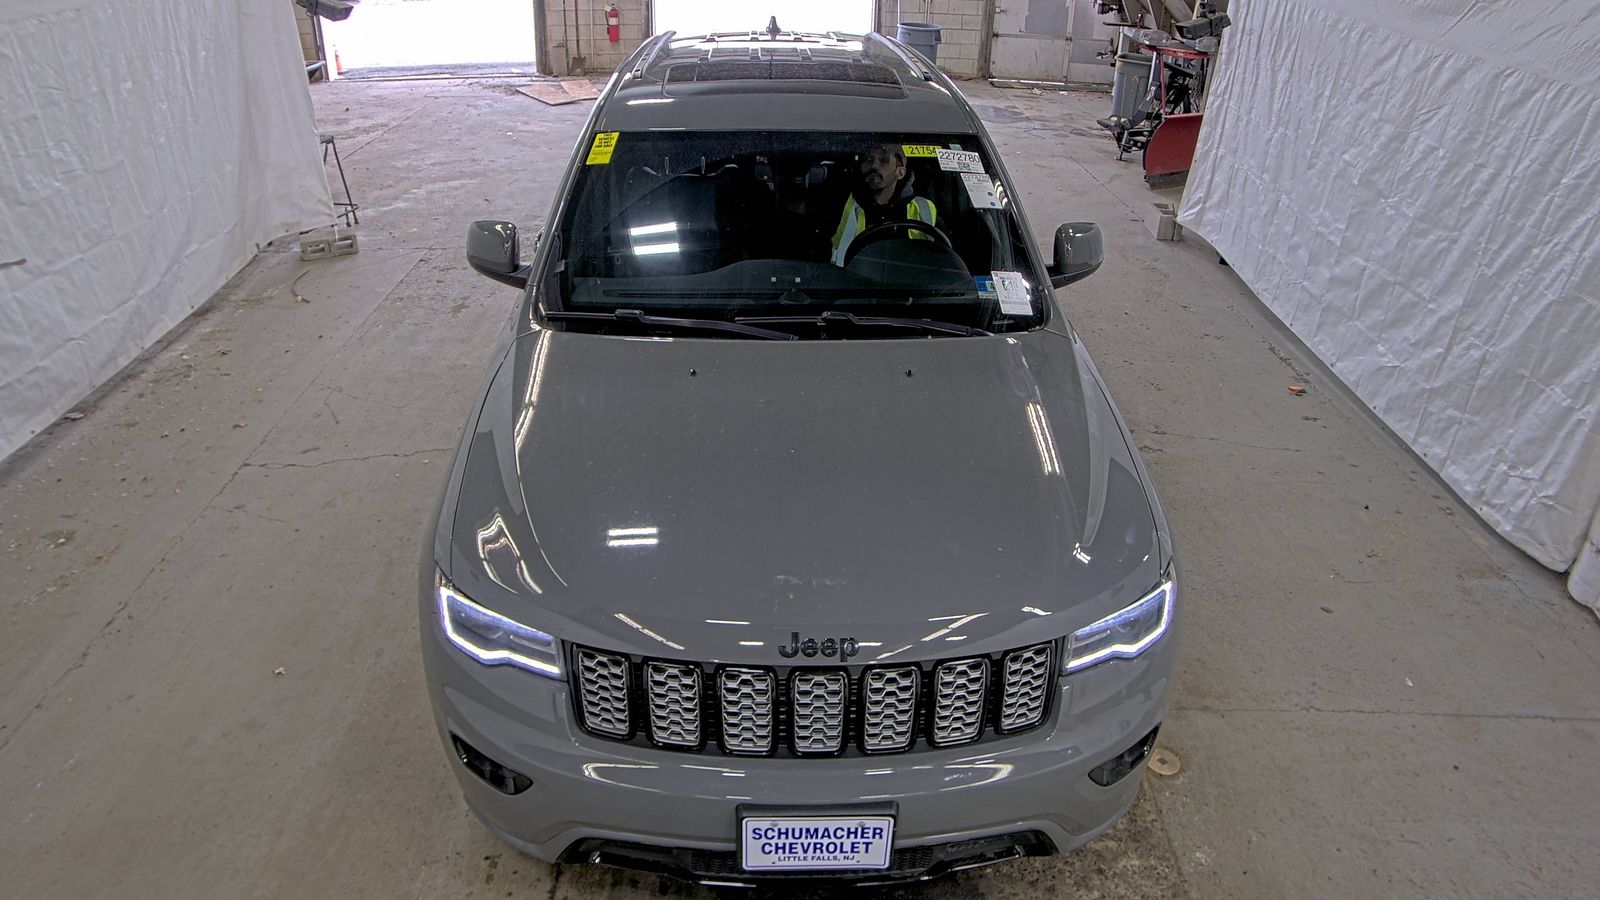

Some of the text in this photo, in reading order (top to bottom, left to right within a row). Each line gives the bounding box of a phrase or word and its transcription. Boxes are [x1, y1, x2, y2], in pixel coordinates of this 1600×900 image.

[908, 146, 937, 155] 21754
[939, 151, 981, 163] 2272780
[778, 632, 860, 662] Jeep
[752, 827, 884, 840] SCHUMACHER
[761, 842, 873, 855] CHEVROLET
